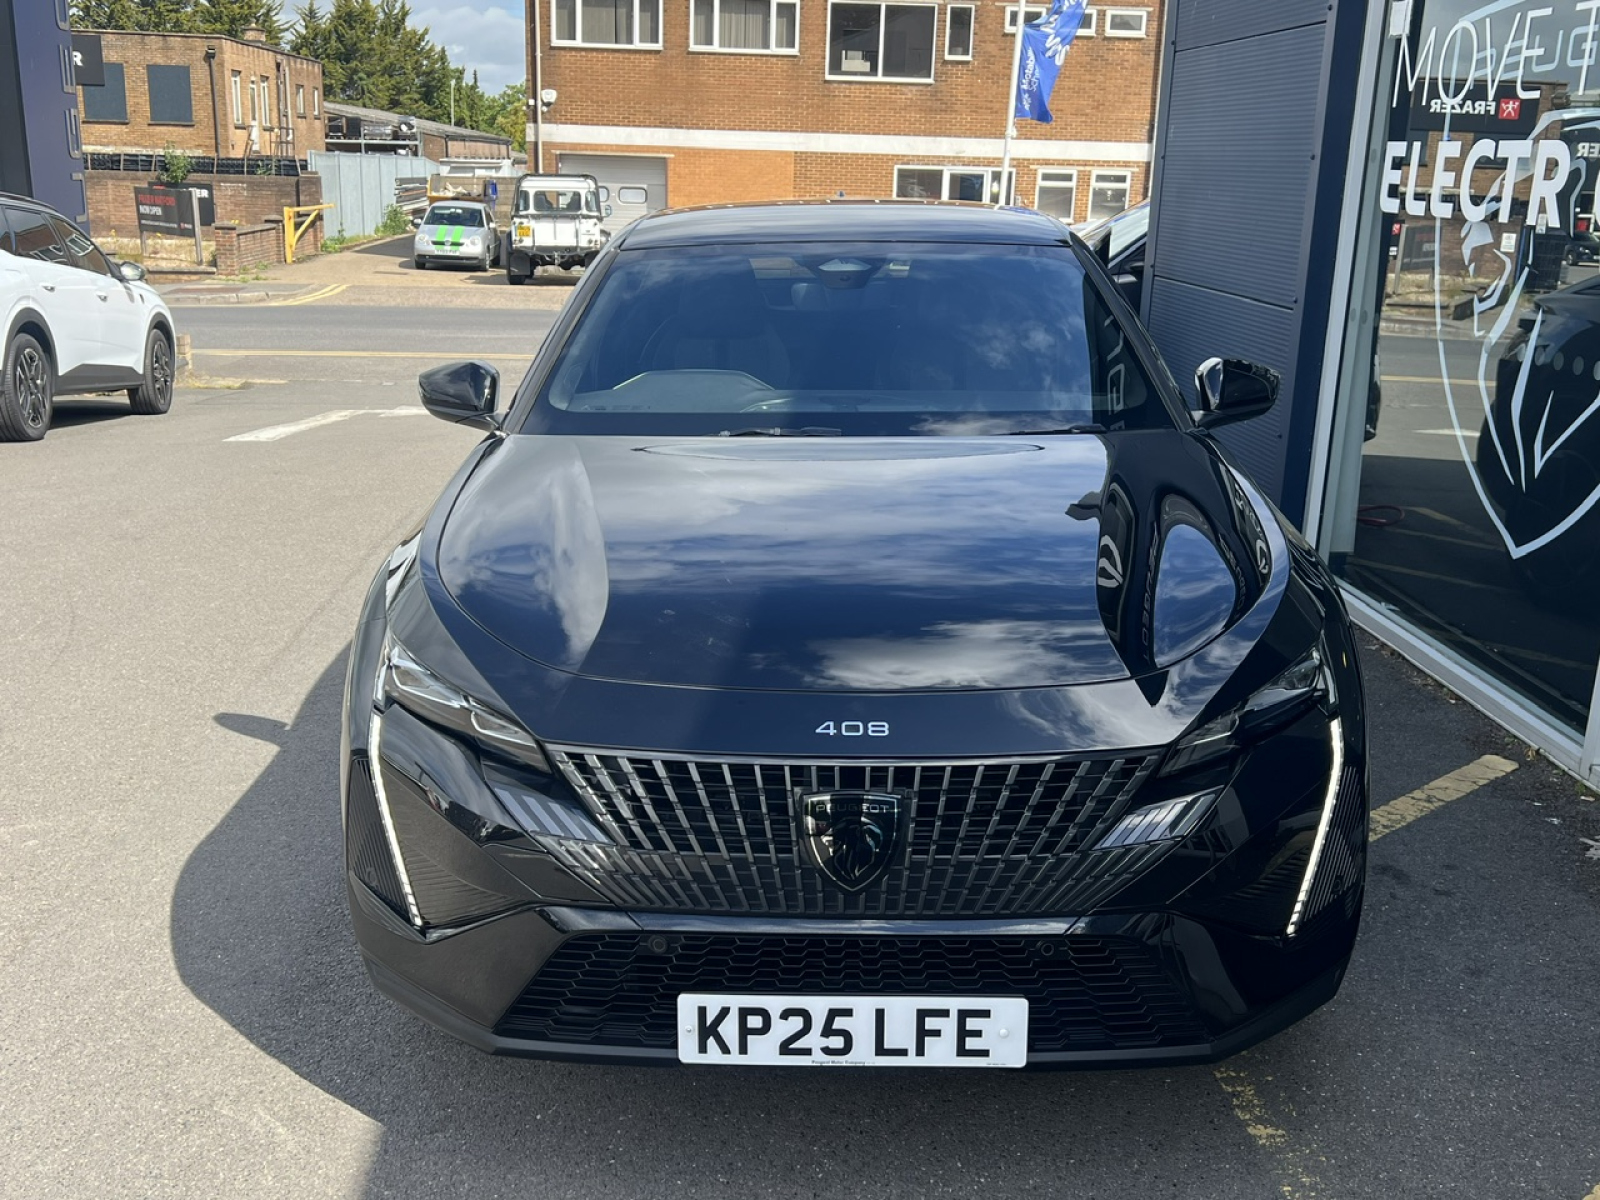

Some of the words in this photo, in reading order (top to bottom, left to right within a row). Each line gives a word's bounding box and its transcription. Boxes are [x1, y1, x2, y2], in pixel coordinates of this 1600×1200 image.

[1392, 7, 1553, 108] MOVE
[1380, 139, 1600, 229] ELECTR
[815, 720, 890, 736] 408
[815, 803, 890, 814] PEUGEOT
[697, 1005, 854, 1057] KP25
[874, 1007, 992, 1058] LFE
